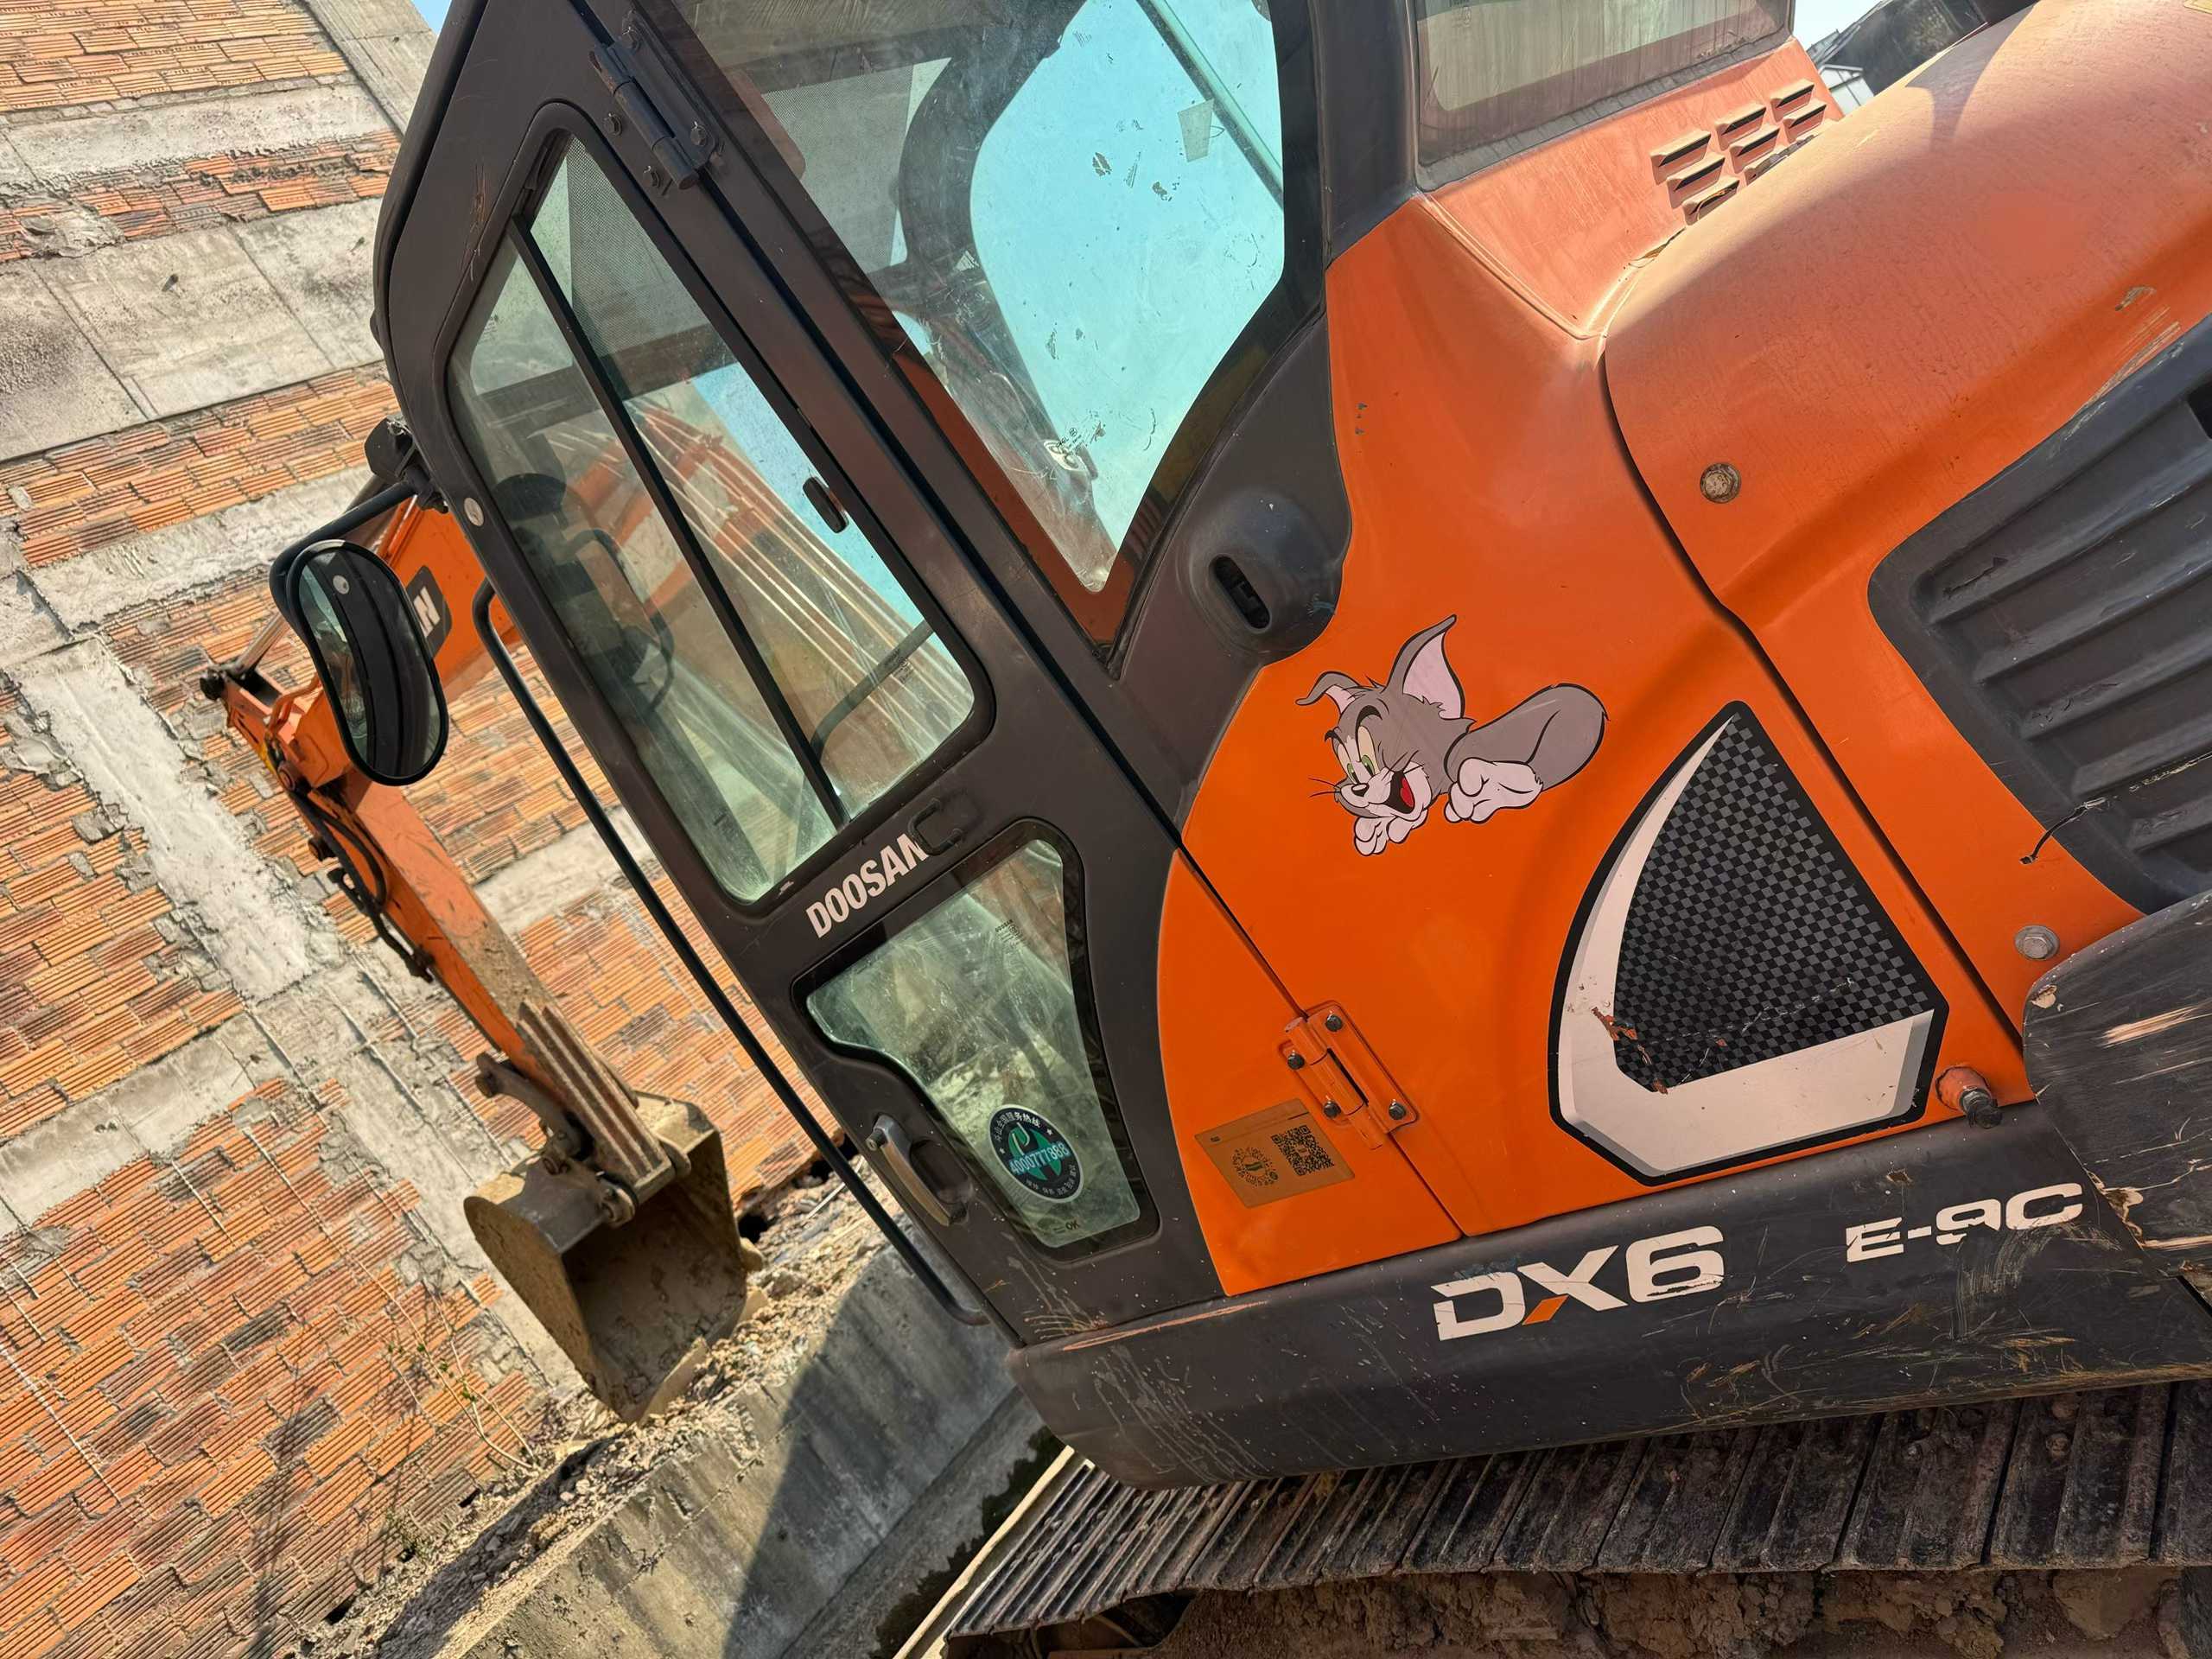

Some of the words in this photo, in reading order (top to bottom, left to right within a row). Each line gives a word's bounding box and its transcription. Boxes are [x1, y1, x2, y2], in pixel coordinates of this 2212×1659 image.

[1009, 1142, 1070, 1173] 4000777888
[1431, 1225, 1726, 1341] DX6
[1846, 1182, 2084, 1263] E-9C
